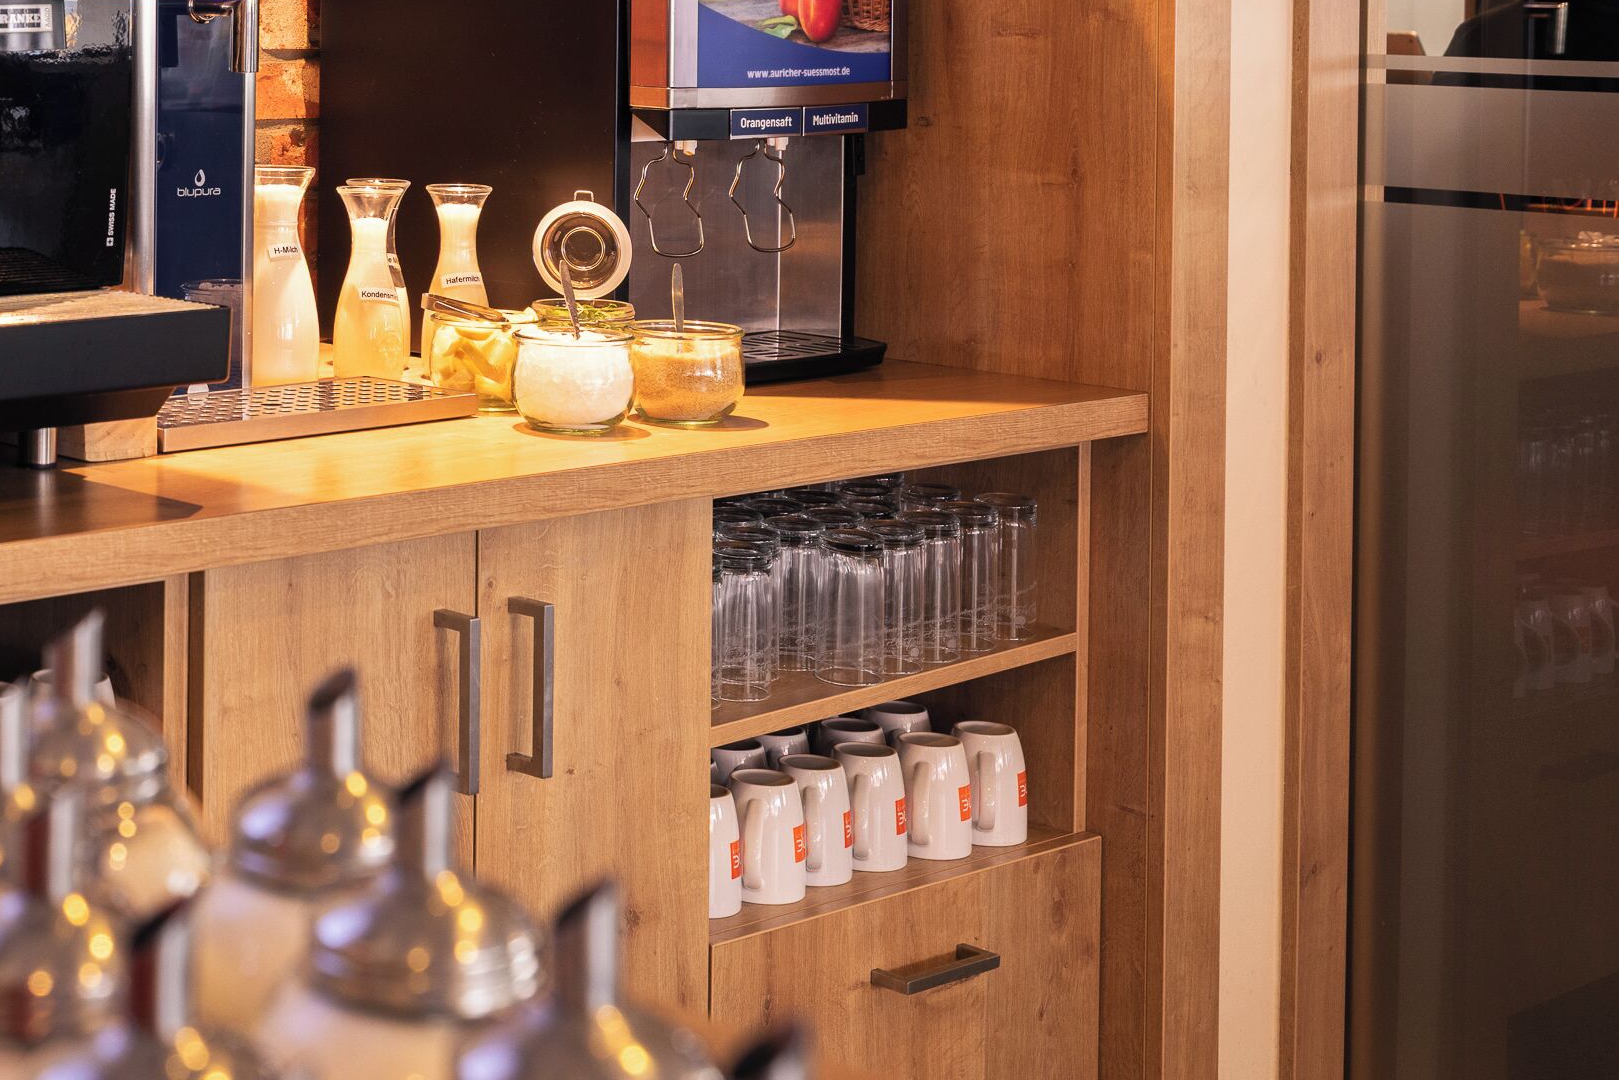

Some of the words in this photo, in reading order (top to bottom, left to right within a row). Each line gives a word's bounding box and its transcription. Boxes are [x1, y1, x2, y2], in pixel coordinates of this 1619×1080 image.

[747, 66, 850, 79] www.auricher-suessmost.de
[740, 116, 792, 130] Orangensaft
[812, 112, 859, 126] Multivitamin
[177, 187, 221, 198] blupura
[109, 188, 117, 211] MADE
[273, 246, 298, 254] H-Milch
